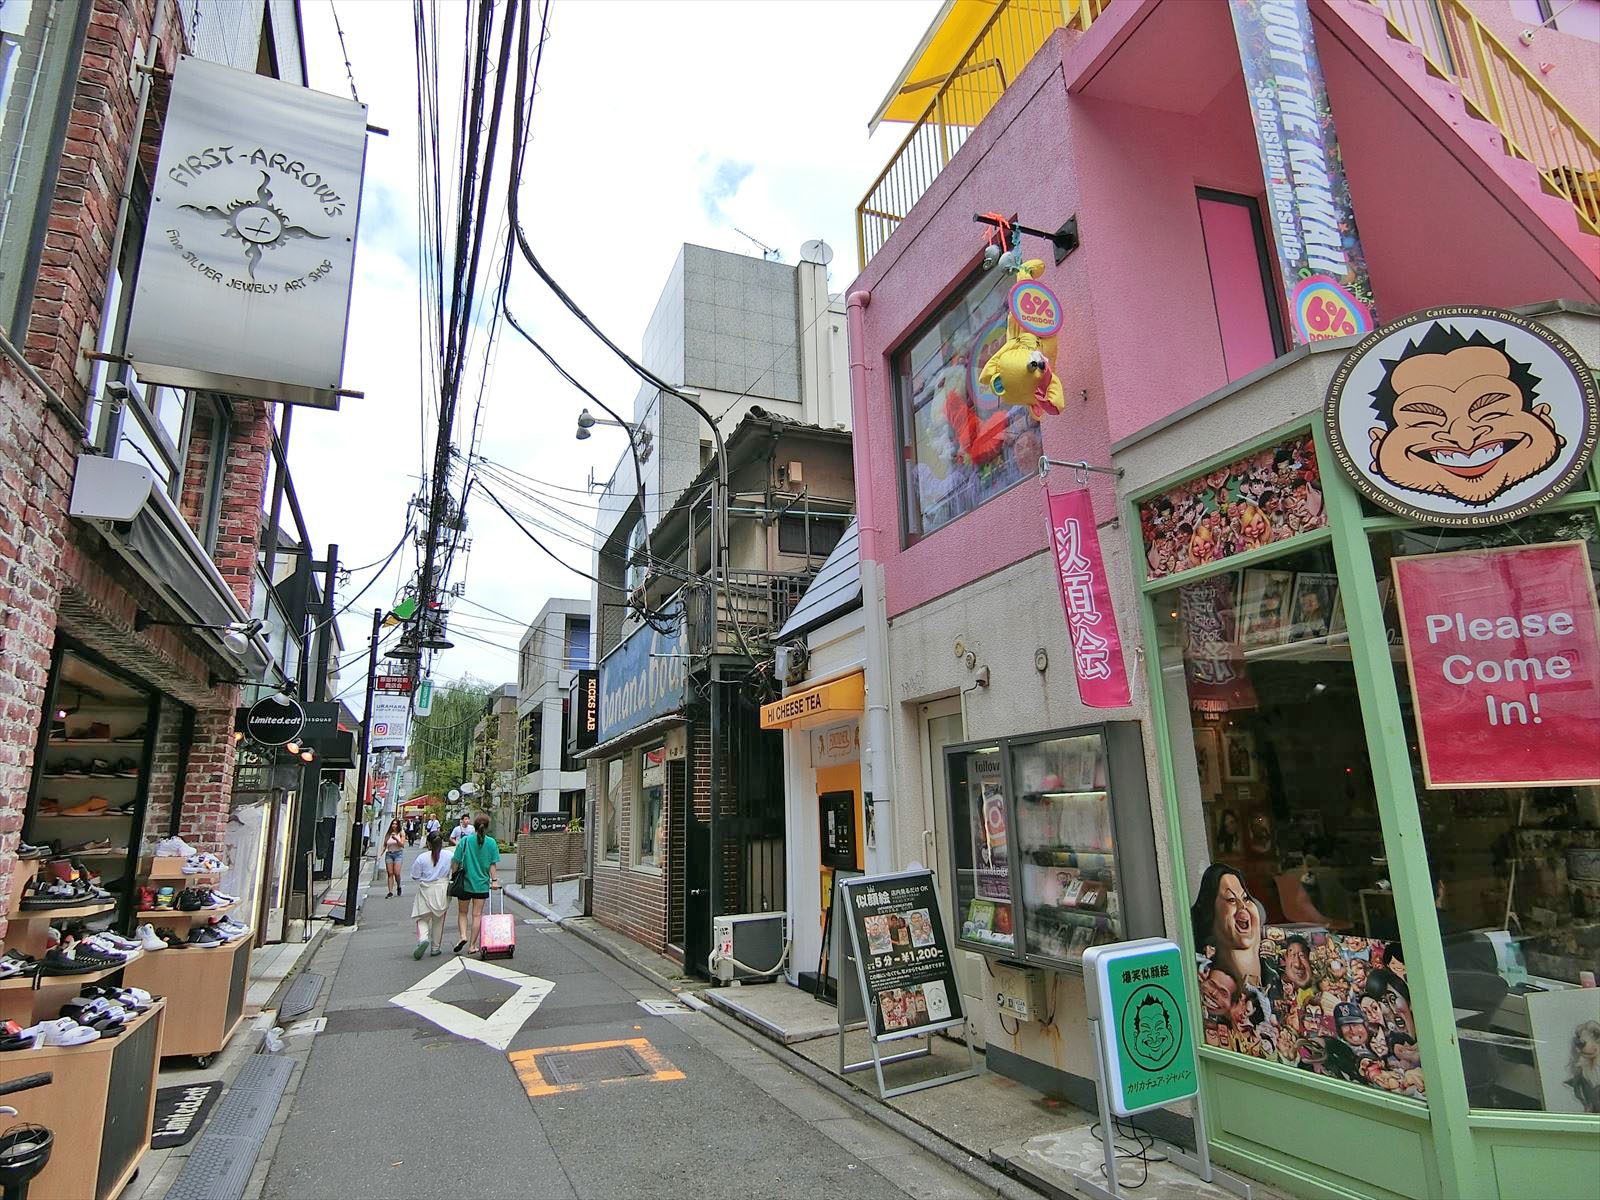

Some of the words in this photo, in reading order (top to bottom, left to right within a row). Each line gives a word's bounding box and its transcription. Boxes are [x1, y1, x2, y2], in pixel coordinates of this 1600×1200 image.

[1275, 75, 1321, 141] THE
[1287, 139, 1348, 276] KAWAII
[166, 228, 184, 252] Fine
[181, 249, 223, 285] SILVER
[226, 277, 279, 295] JEWELY
[284, 277, 308, 293] ART
[309, 258, 333, 284] SHOP
[1019, 292, 1054, 318] 6%
[1306, 296, 1354, 335] 6%
[1426, 307, 1479, 317] Caricature
[1481, 309, 1497, 318] art
[1379, 315, 1418, 336] features
[1499, 312, 1528, 326] mixes
[1529, 322, 1558, 344] humor
[1346, 335, 1379, 368] individual
[1556, 342, 1573, 359] and
[1332, 367, 1348, 396] unique
[1569, 357, 1591, 389] artistic
[1327, 396, 1337, 418] their
[1587, 388, 1599, 431] expression
[1327, 418, 1336, 430] of
[1584, 432, 1597, 449] by
[1328, 430, 1360, 481] exaggeration
[1552, 450, 1591, 495] uncovering
[1358, 478, 1373, 496] the
[1377, 491, 1409, 514] through
[1536, 491, 1554, 508] one's
[1409, 509, 1469, 526] personality
[1472, 505, 1535, 526] underlying
[1425, 612, 1574, 644] Please
[1442, 654, 1572, 685] Come
[587, 678, 597, 709] KICKS
[602, 664, 647, 735] banana
[249, 715, 301, 725] Limited.edt
[767, 707, 775, 724] HI
[776, 699, 804, 720] CHEESE
[805, 693, 822, 711] TEA
[1486, 692, 1542, 726] In!
[586, 710, 596, 732] LAB
[855, 890, 891, 908] 似顔絵
[1122, 964, 1170, 984] 爆笑似顔絵
